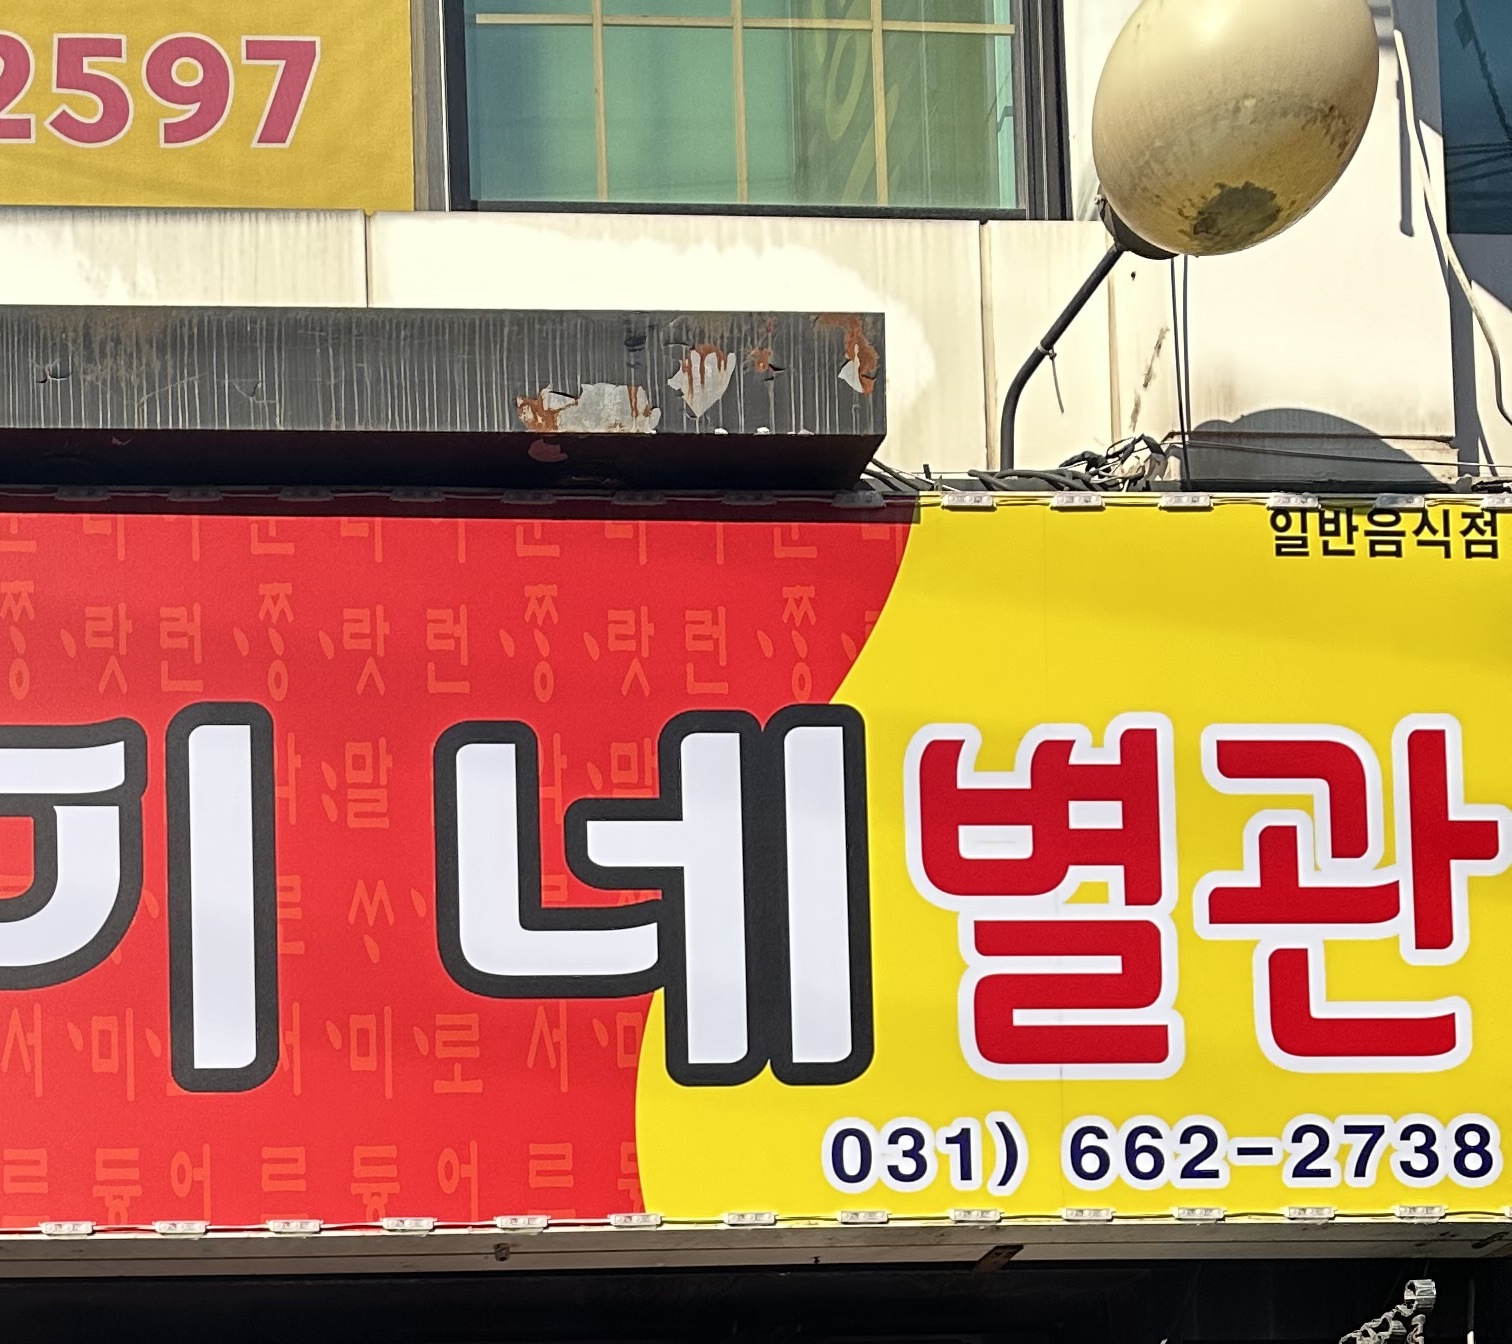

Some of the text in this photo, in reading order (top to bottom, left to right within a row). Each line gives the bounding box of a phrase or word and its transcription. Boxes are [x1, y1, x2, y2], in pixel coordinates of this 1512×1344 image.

[1268, 508, 1500, 559] 일반음식점
[905, 713, 1511, 1080] 별관
[825, 1116, 1499, 1192] 031) 662-2738
